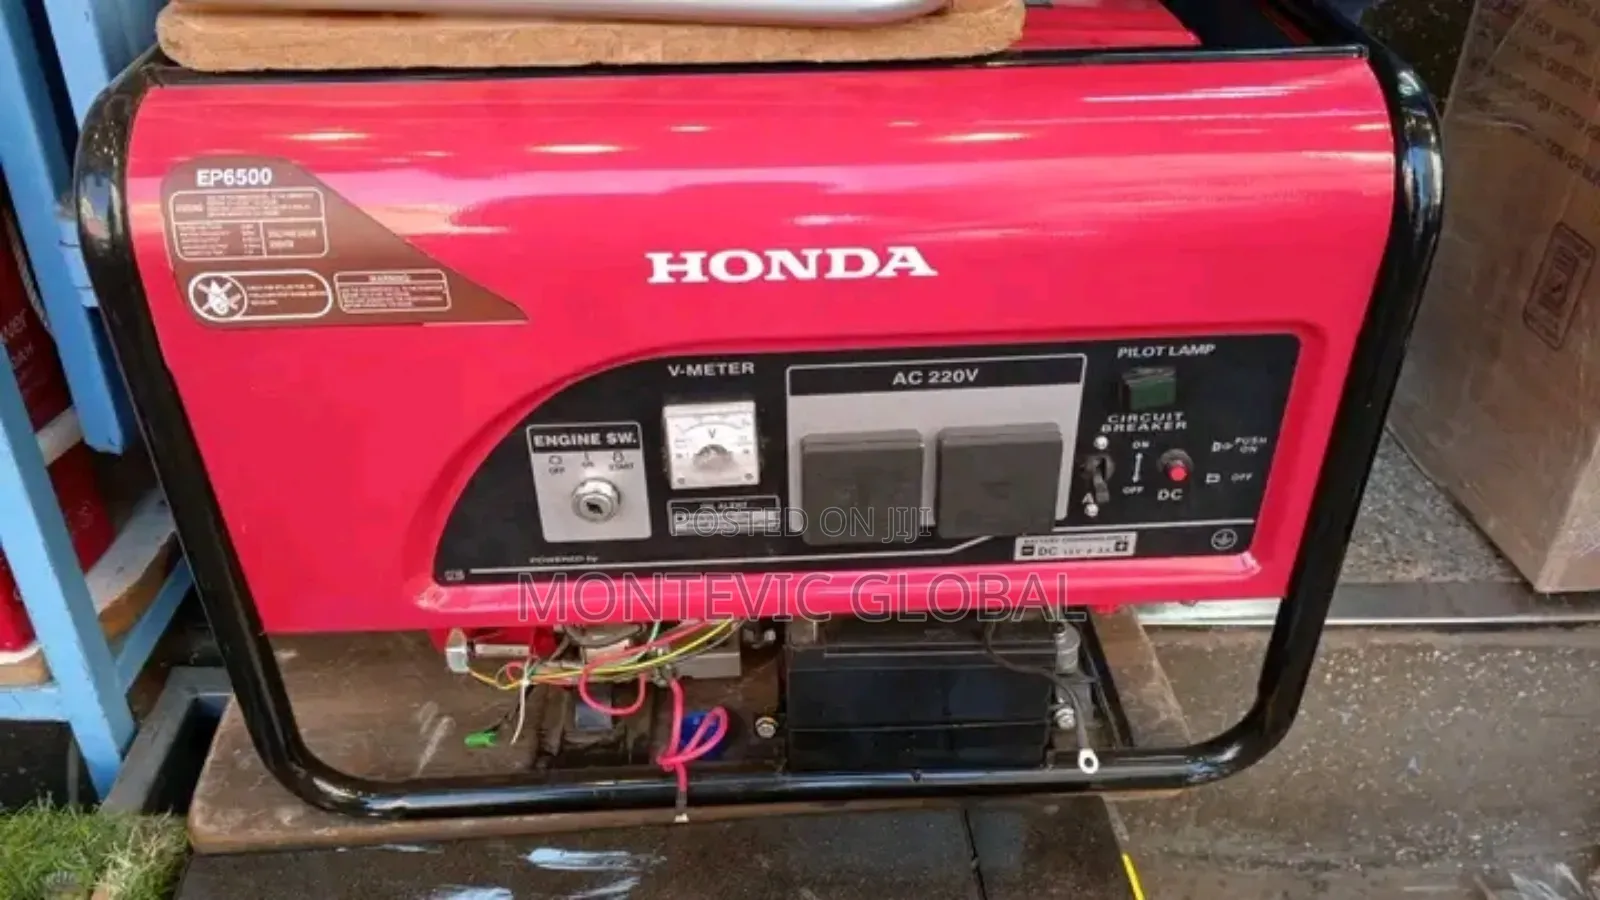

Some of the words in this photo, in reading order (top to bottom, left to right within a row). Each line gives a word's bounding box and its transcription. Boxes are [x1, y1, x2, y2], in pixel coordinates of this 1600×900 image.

[196, 167, 273, 187] EP6500
[645, 246, 939, 284] HONDA
[1117, 346, 1164, 359] PILOT
[1168, 344, 1216, 357] LAMP
[667, 361, 755, 377] V-METER
[892, 371, 923, 386] AC
[928, 368, 979, 384] 220V
[1107, 412, 1185, 424] CIRCUIT
[708, 428, 716, 439] V
[1101, 421, 1188, 434] BREAKER
[533, 433, 602, 448] ENGINE
[606, 431, 638, 445] SW.
[1132, 440, 1150, 449] ON
[1122, 486, 1144, 495] OFF
[1157, 488, 1184, 501] DC
[1038, 546, 1059, 556] DC
